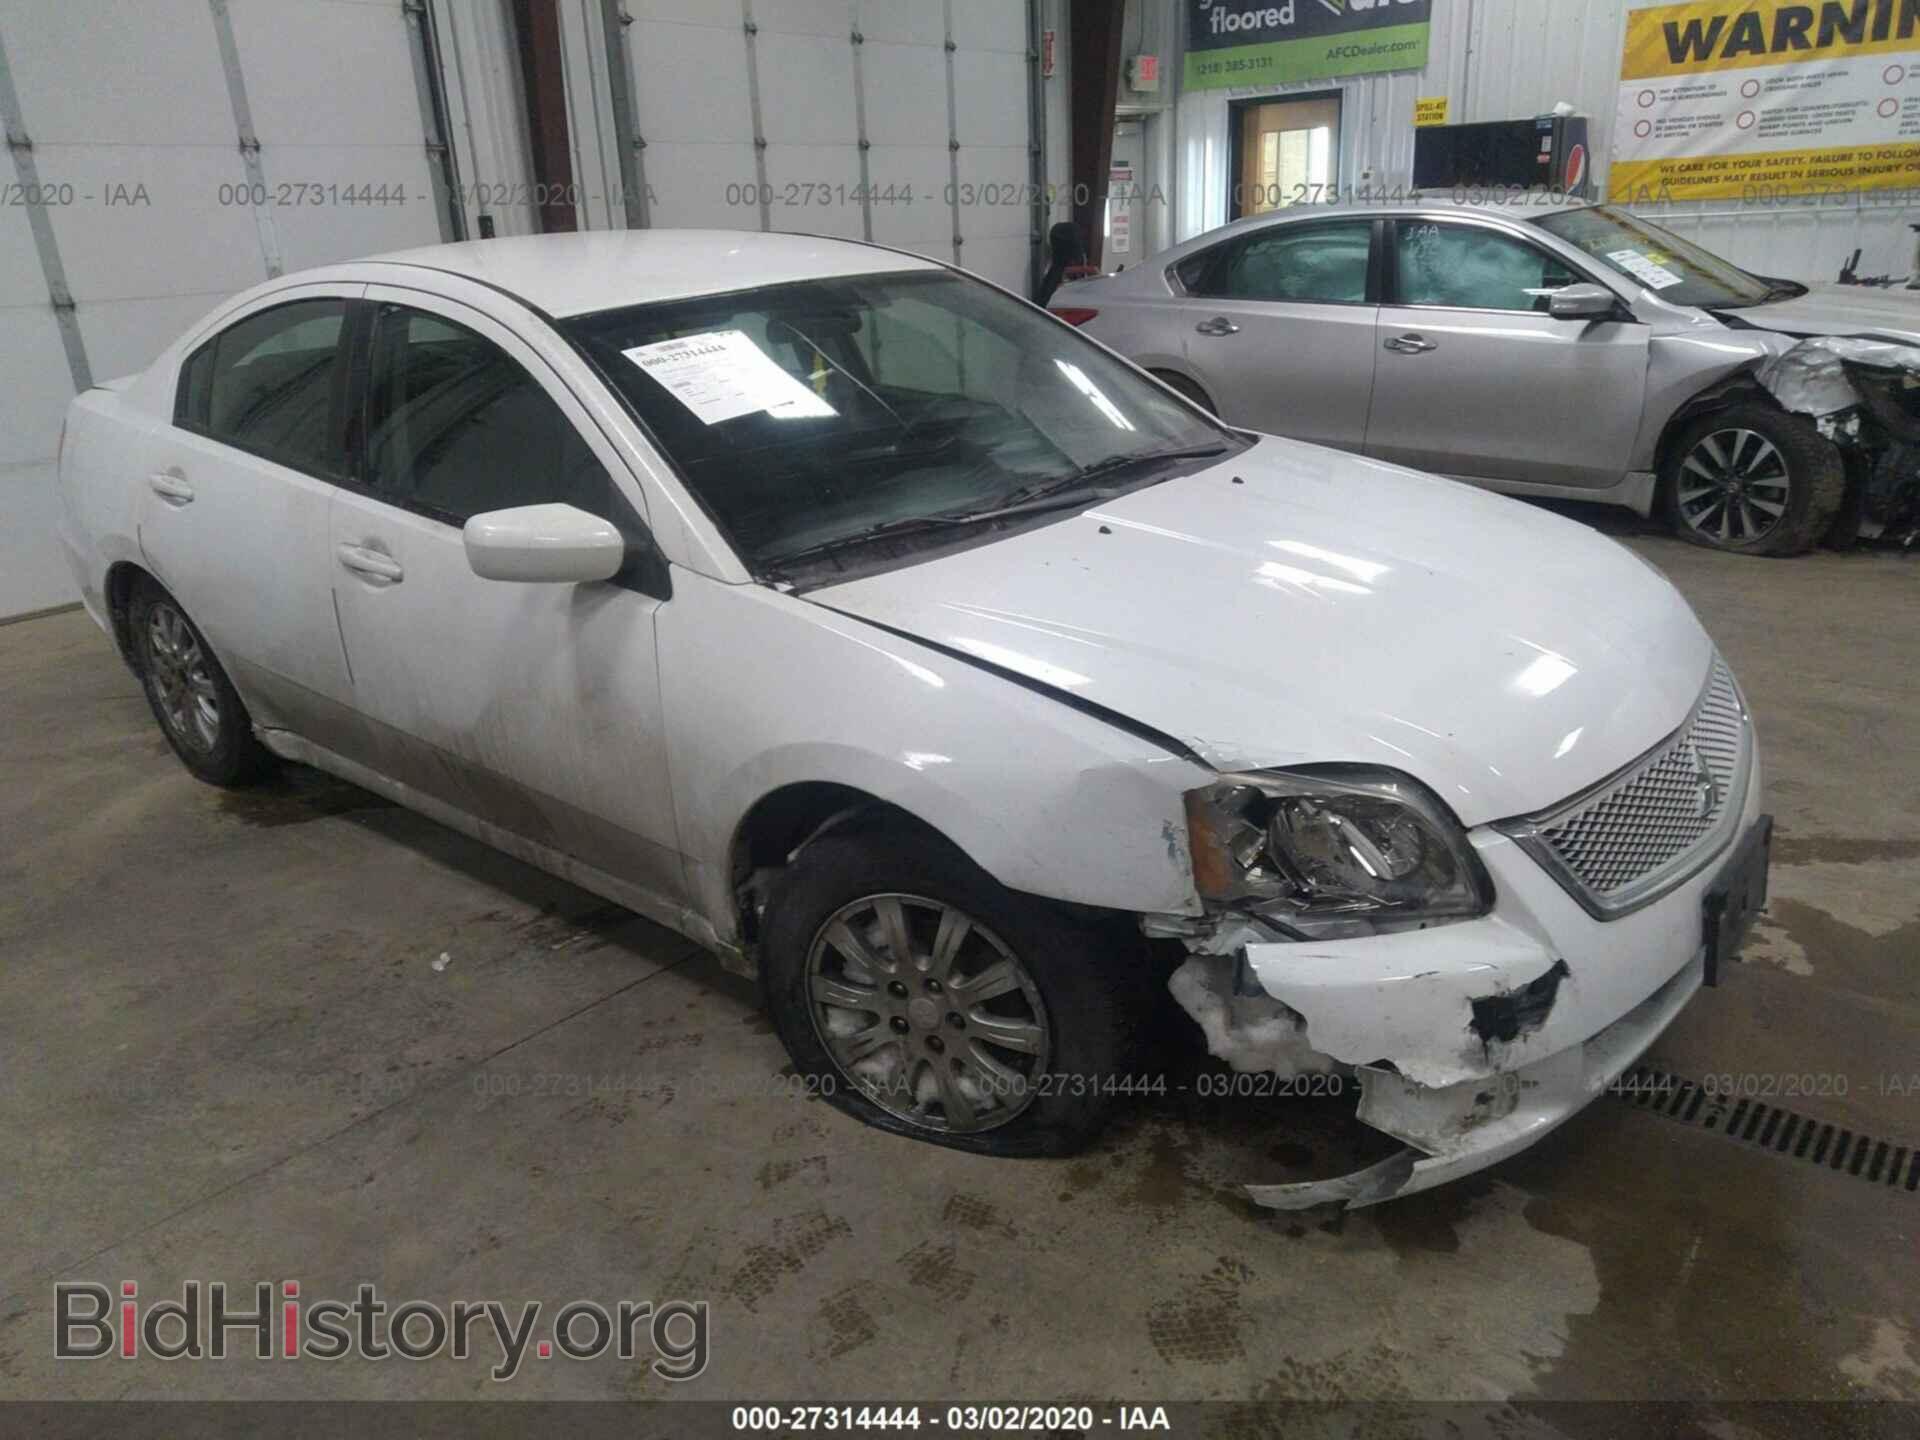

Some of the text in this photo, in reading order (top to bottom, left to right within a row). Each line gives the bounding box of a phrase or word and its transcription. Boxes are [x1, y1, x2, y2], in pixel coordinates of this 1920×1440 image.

[1210, 0, 1295, 33] floored
[1678, 162, 1704, 172] CARE
[1708, 161, 1728, 170] FOR
[1732, 160, 1761, 169] YOUR
[1810, 152, 1853, 163] FAILURE
[1857, 151, 1873, 161] TO
[1661, 175, 1720, 186] GUIDELINES
[1723, 174, 1746, 183] MAY
[1750, 171, 1786, 182] RESULT
[1807, 167, 1854, 178] SERIOUS
[1857, 164, 1902, 175] INJURY
